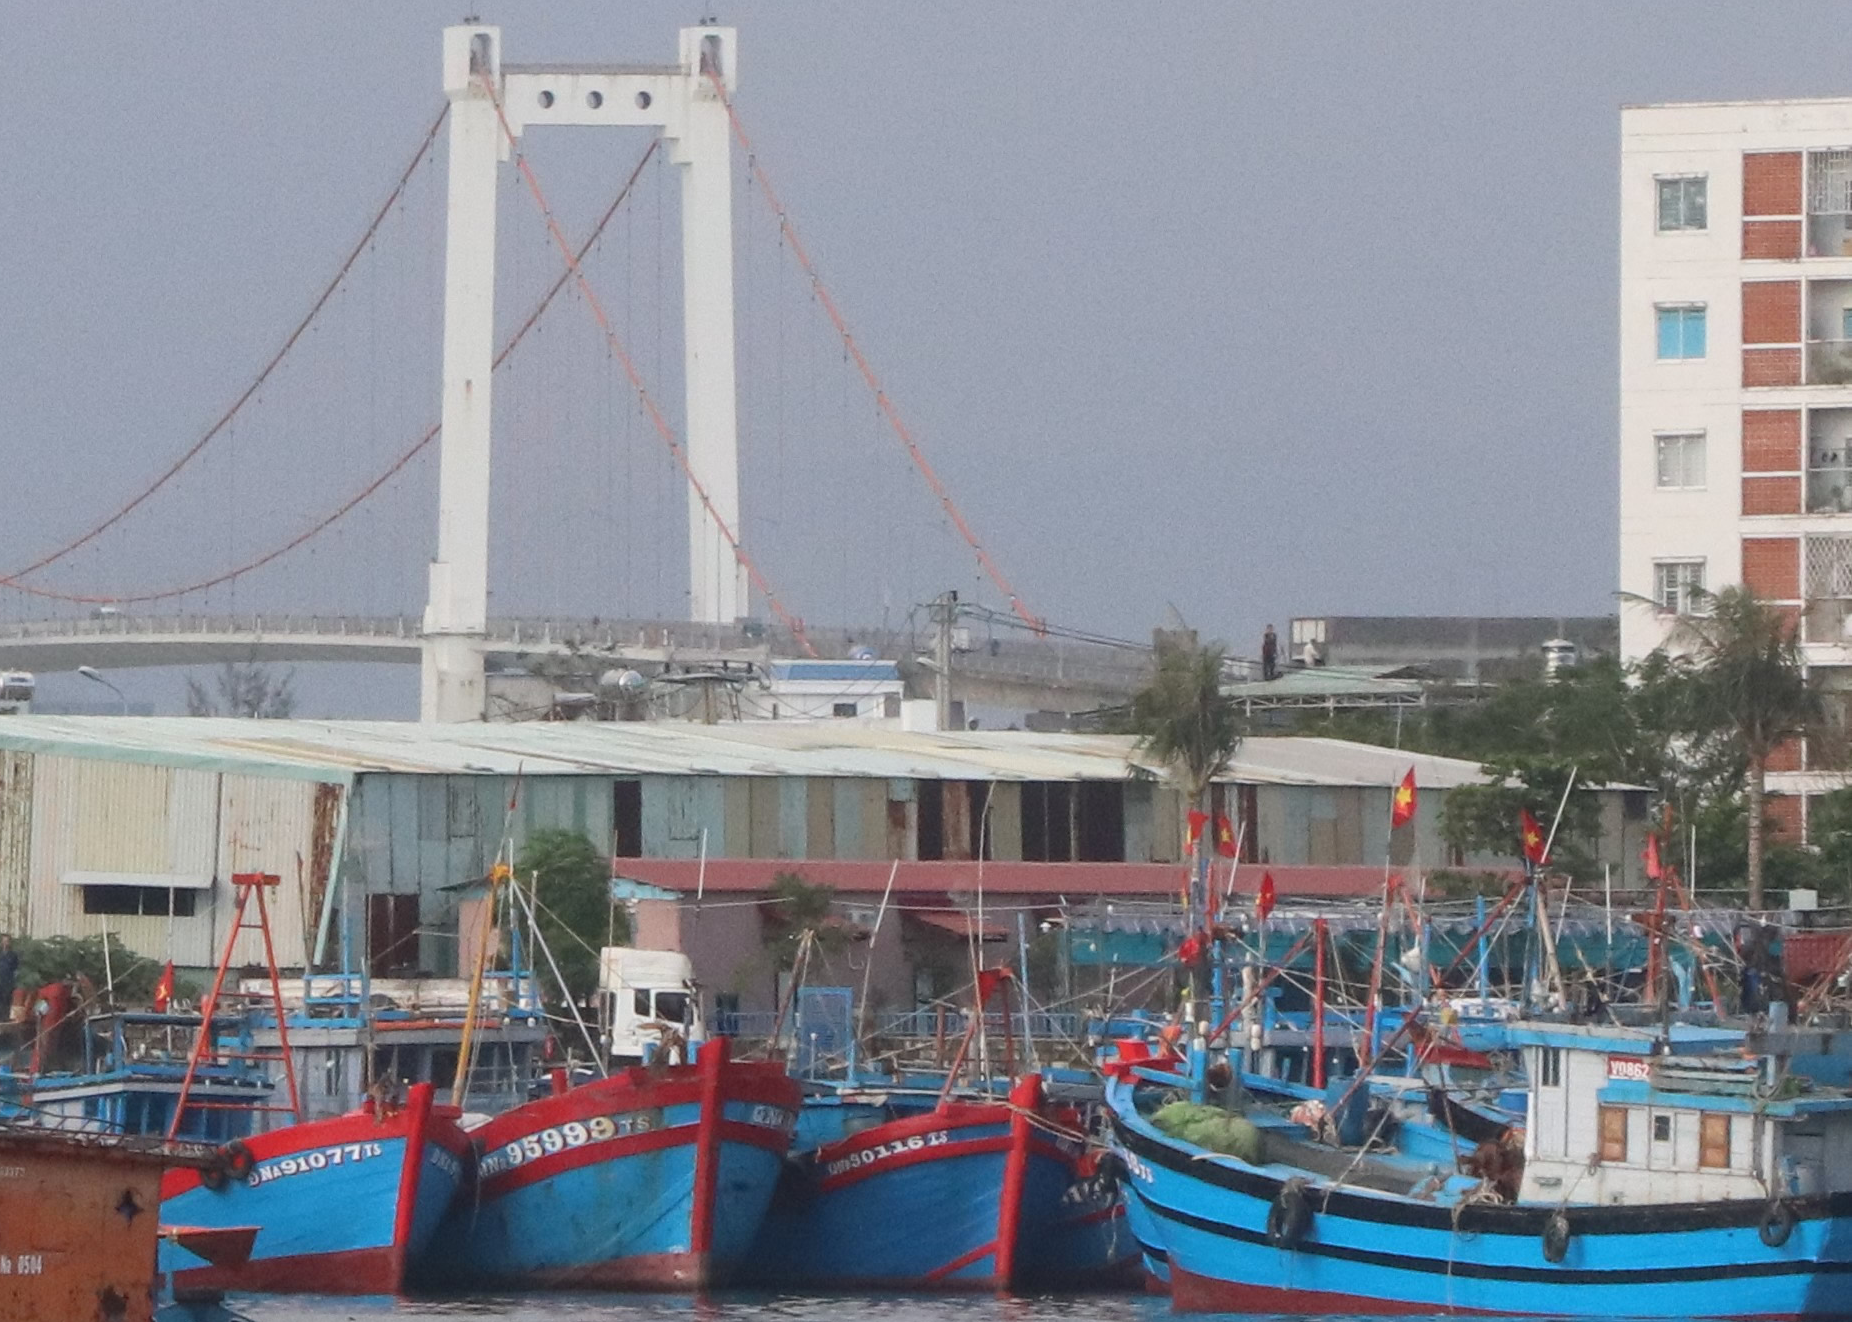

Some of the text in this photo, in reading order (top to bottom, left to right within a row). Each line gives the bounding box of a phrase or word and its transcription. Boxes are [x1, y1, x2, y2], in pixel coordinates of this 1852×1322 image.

[280, 1143, 363, 1175] 91077
[364, 1142, 382, 1159] TS
[505, 1116, 617, 1165] 95999
